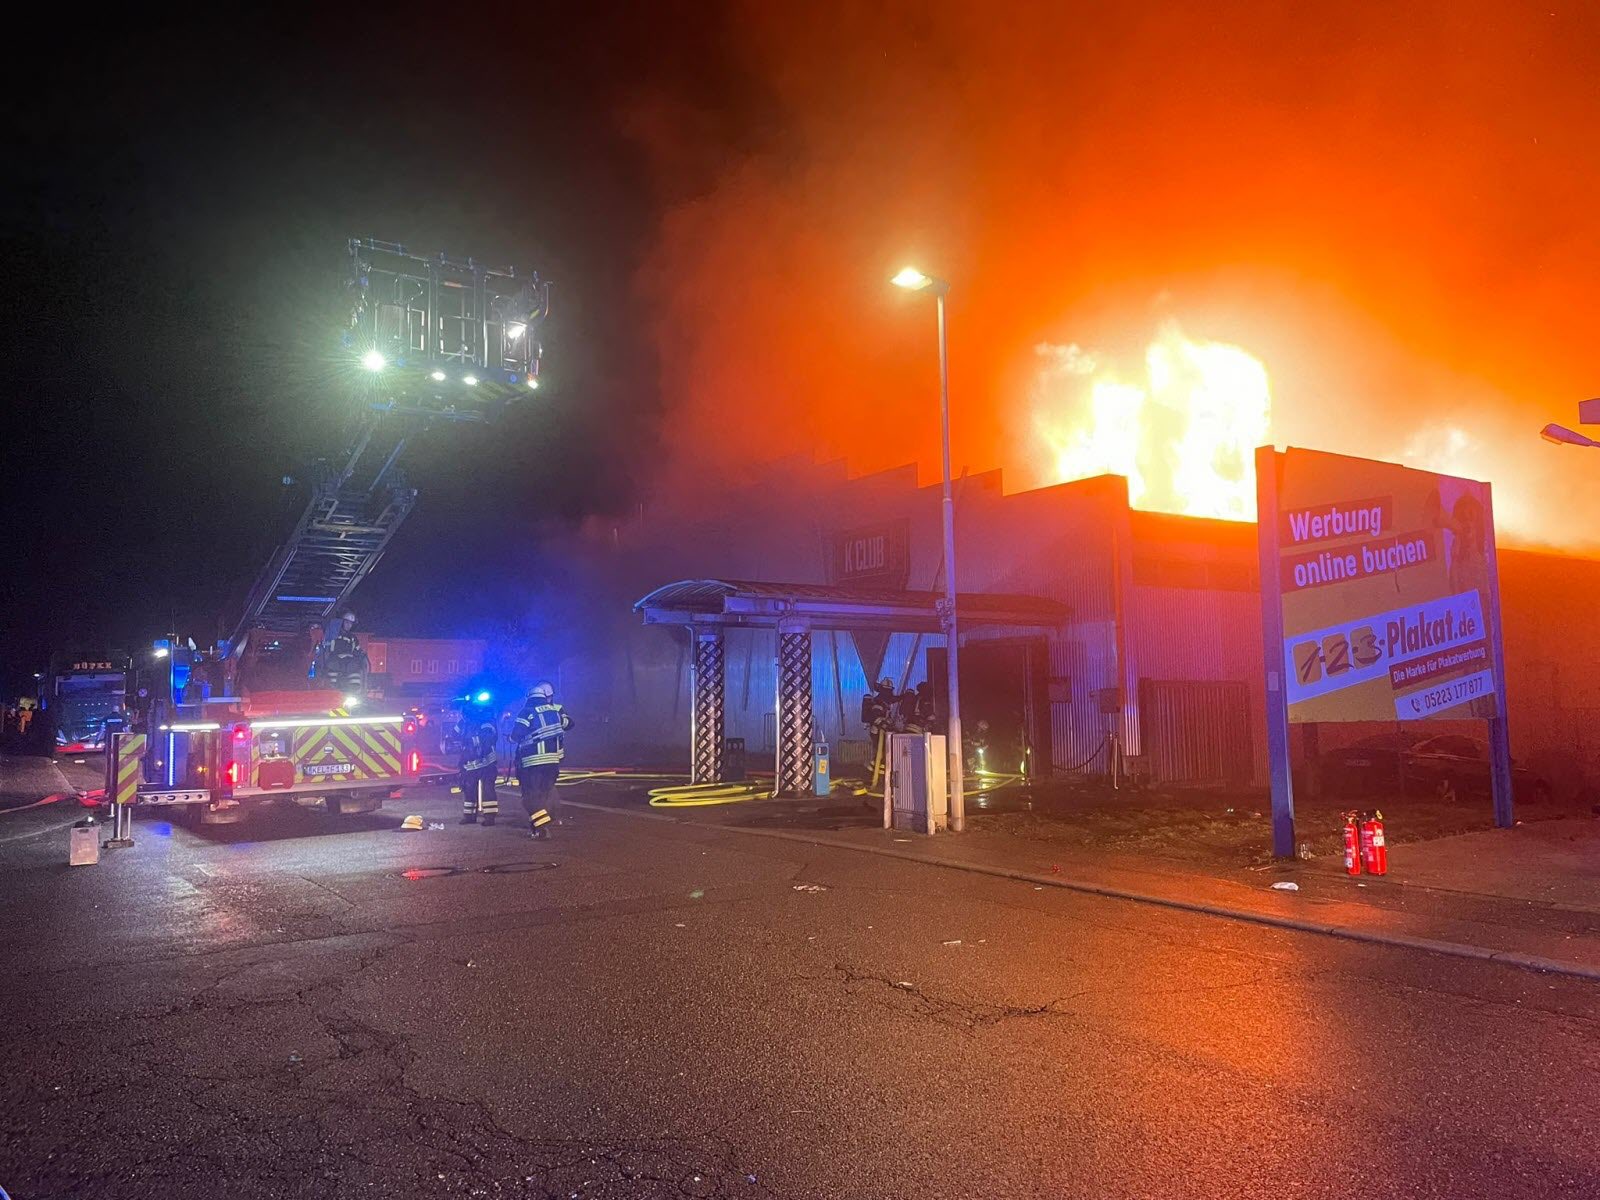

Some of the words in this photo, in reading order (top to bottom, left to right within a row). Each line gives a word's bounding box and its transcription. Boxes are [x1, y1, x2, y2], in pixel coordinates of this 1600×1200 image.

[1289, 506, 1382, 542] Werbung
[844, 541, 853, 573] K
[855, 536, 885, 572] CLUB
[1294, 551, 1357, 587] online
[1362, 538, 1428, 574] buchen
[1393, 670, 1406, 683] Die
[1406, 665, 1426, 680] Marke
[1426, 660, 1438, 675] für
[1438, 647, 1486, 669] Plakatwerbung
[1424, 687, 1453, 710] 05223
